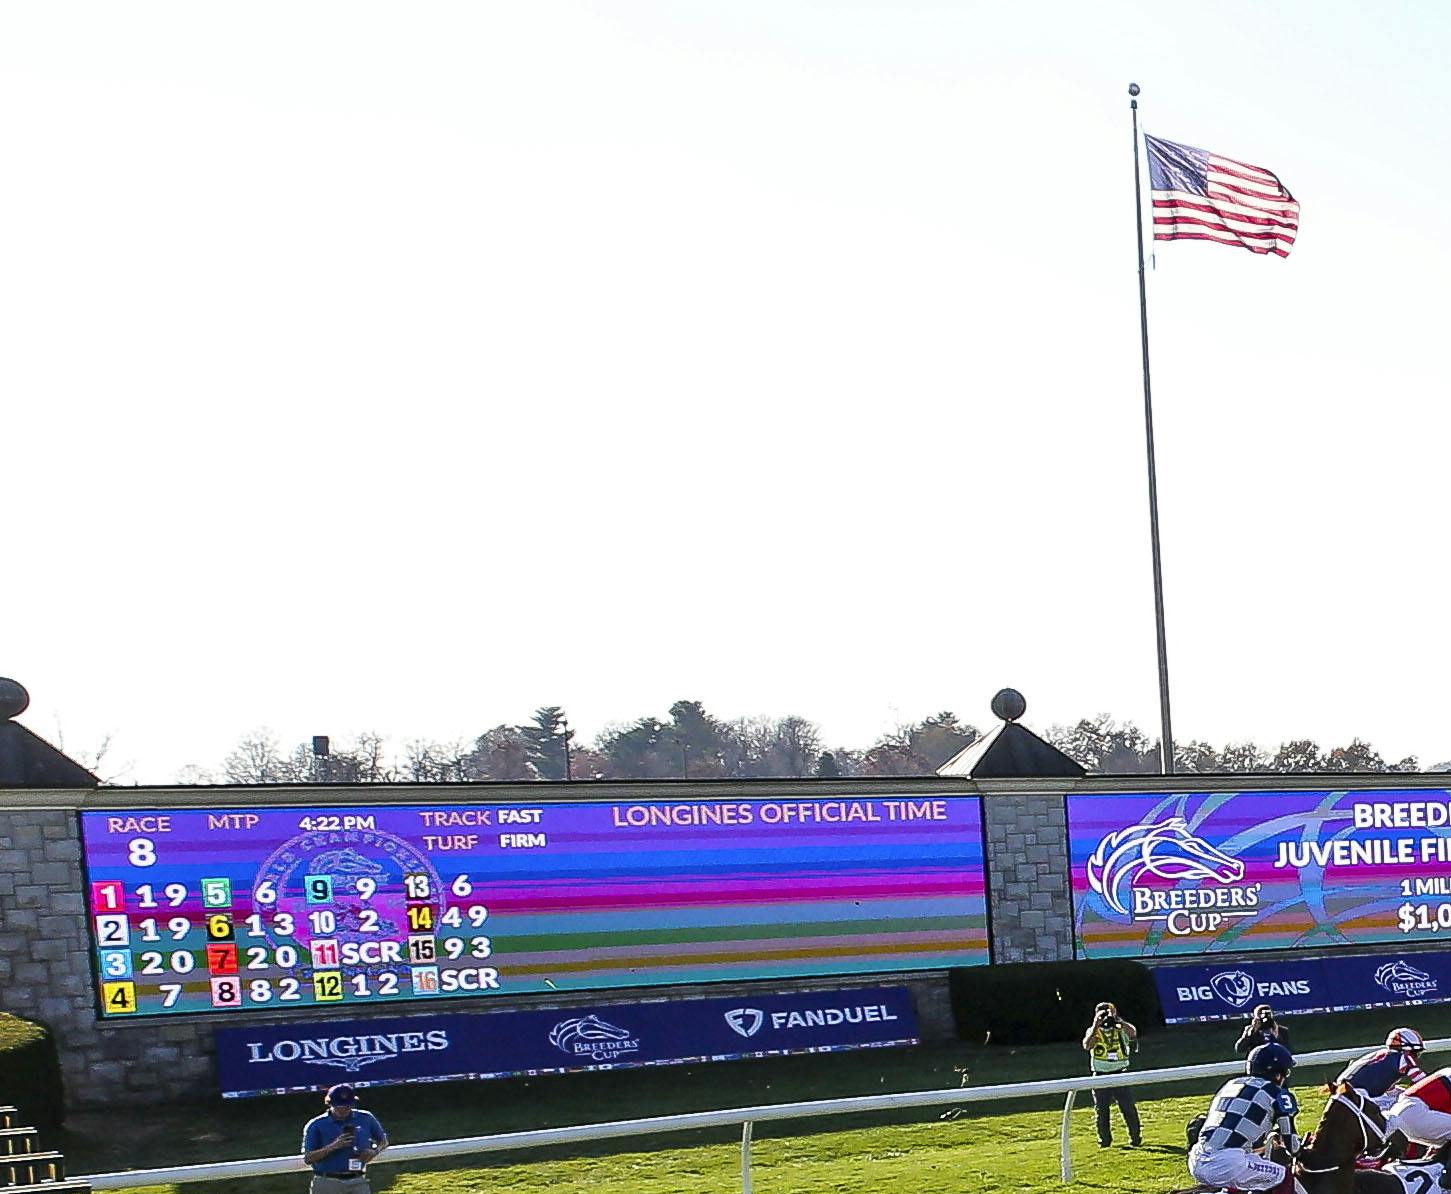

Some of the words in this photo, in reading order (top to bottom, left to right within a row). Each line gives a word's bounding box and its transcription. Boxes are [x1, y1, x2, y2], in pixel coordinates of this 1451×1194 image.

[107, 816, 173, 834] RACE
[208, 813, 260, 830] MTP
[299, 816, 342, 832] 4:22
[343, 815, 376, 830] PM
[418, 810, 491, 827] TRACK
[497, 809, 544, 825] FAST
[611, 803, 755, 828] LONGINES
[758, 801, 882, 825] OFFICIAL
[883, 799, 948, 822] TIME
[128, 837, 157, 867] 8
[422, 834, 479, 851] TURF
[499, 833, 547, 849] FIRM
[1273, 831, 1415, 869] JUVENILE
[100, 887, 118, 910] 1
[205, 882, 226, 904] 5
[254, 881, 277, 904] 6
[311, 879, 329, 900] 9
[355, 877, 377, 900] 9
[404, 875, 431, 899] 13
[450, 875, 473, 897] 6
[1400, 878, 1413, 896] 1
[1132, 882, 1261, 916] BREEDERS'
[209, 915, 231, 939] 6
[308, 911, 336, 935] 10
[357, 910, 380, 933] 2
[406, 906, 433, 930] 14
[1166, 910, 1223, 936] CUP
[103, 921, 121, 943] 2
[210, 950, 229, 973] 7
[315, 943, 338, 966] 11
[340, 941, 403, 965] SCR
[410, 939, 434, 961] 15
[103, 955, 124, 977] 3
[216, 980, 236, 1003] 8
[318, 974, 342, 998] 12
[440, 967, 501, 993] SCR
[1177, 984, 1213, 1003] BIG
[1257, 979, 1312, 998] FANS
[110, 987, 130, 1010] 4
[158, 983, 183, 1007] 7
[771, 1005, 898, 1029] FANDUEL
[247, 1030, 449, 1063] LONGINES
[591, 1050, 621, 1061] CUP
[1283, 1094, 1293, 1109] 3
